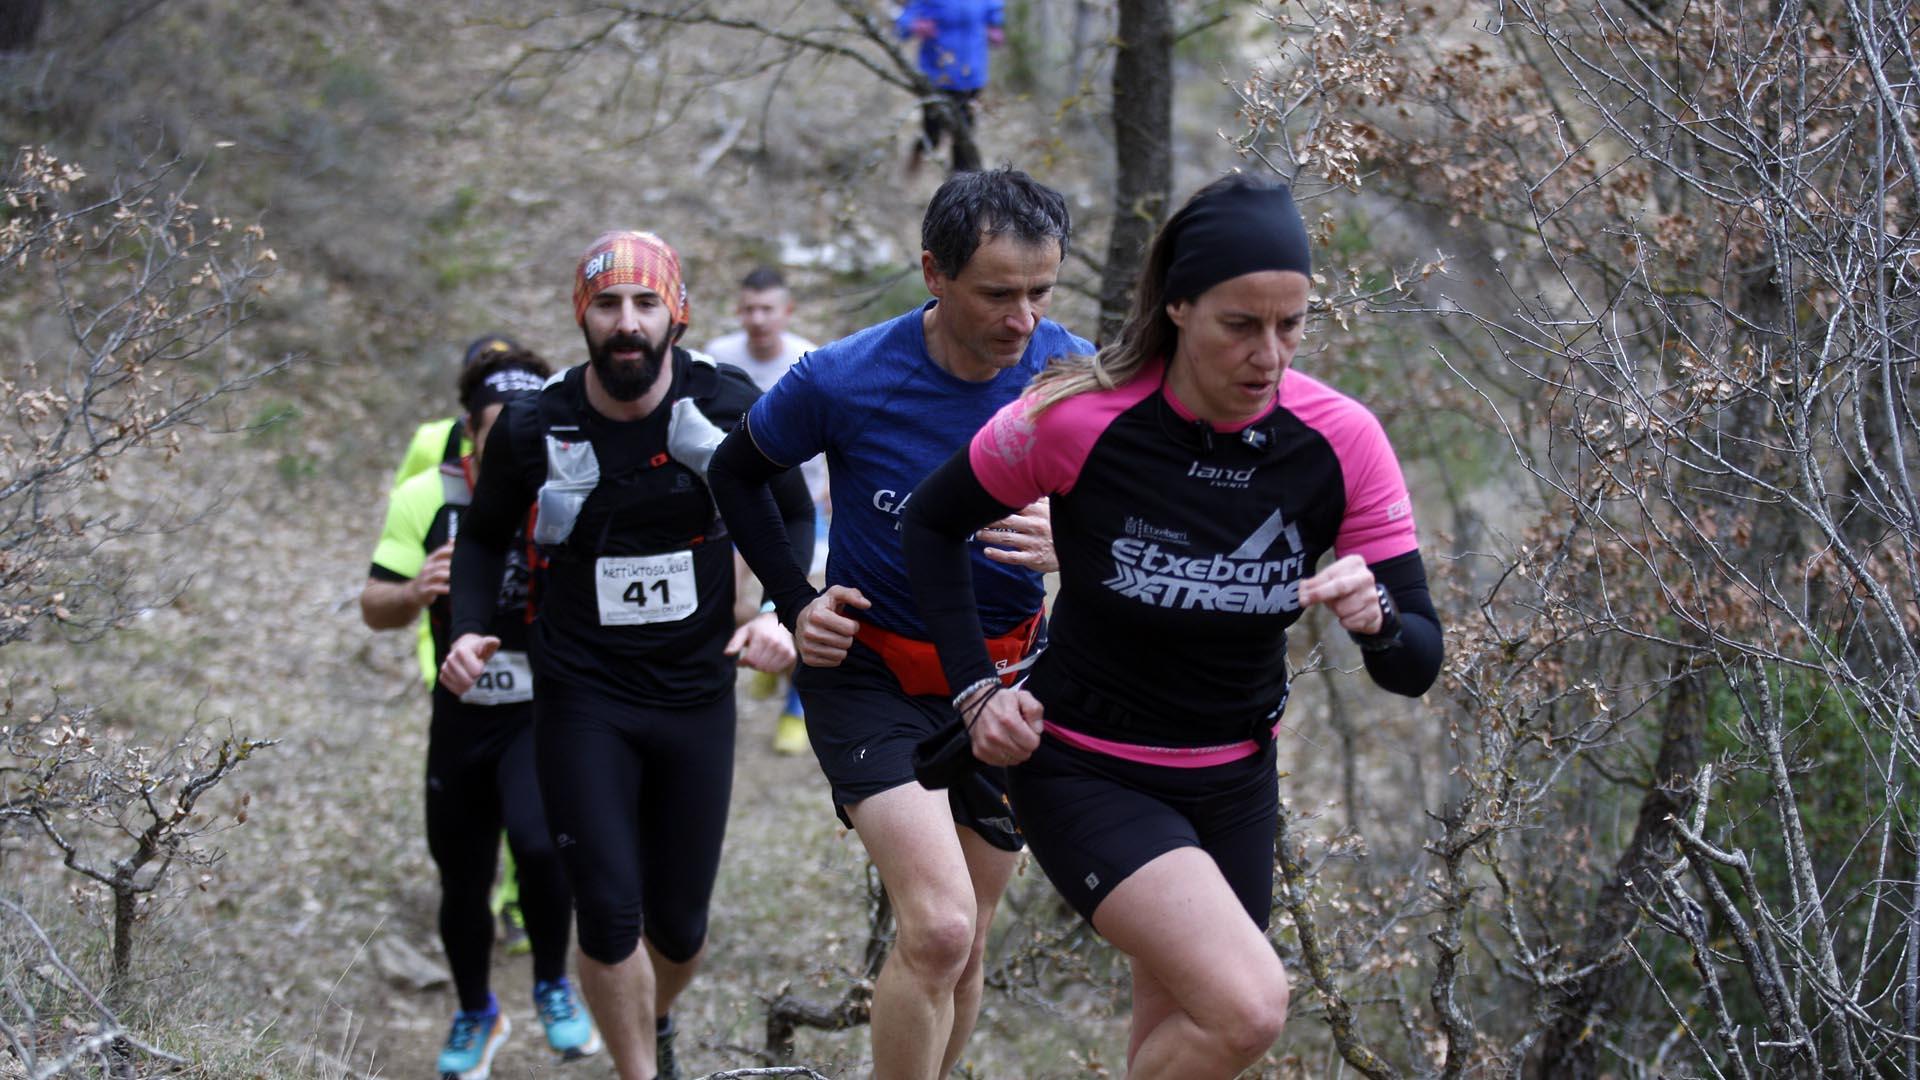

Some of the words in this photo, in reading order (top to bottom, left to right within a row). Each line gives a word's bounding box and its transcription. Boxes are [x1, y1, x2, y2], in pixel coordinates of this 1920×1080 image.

[1187, 461, 1257, 481] land
[1111, 537, 1306, 584] Etxebarri
[622, 578, 670, 607] 41
[476, 670, 515, 692] 40
